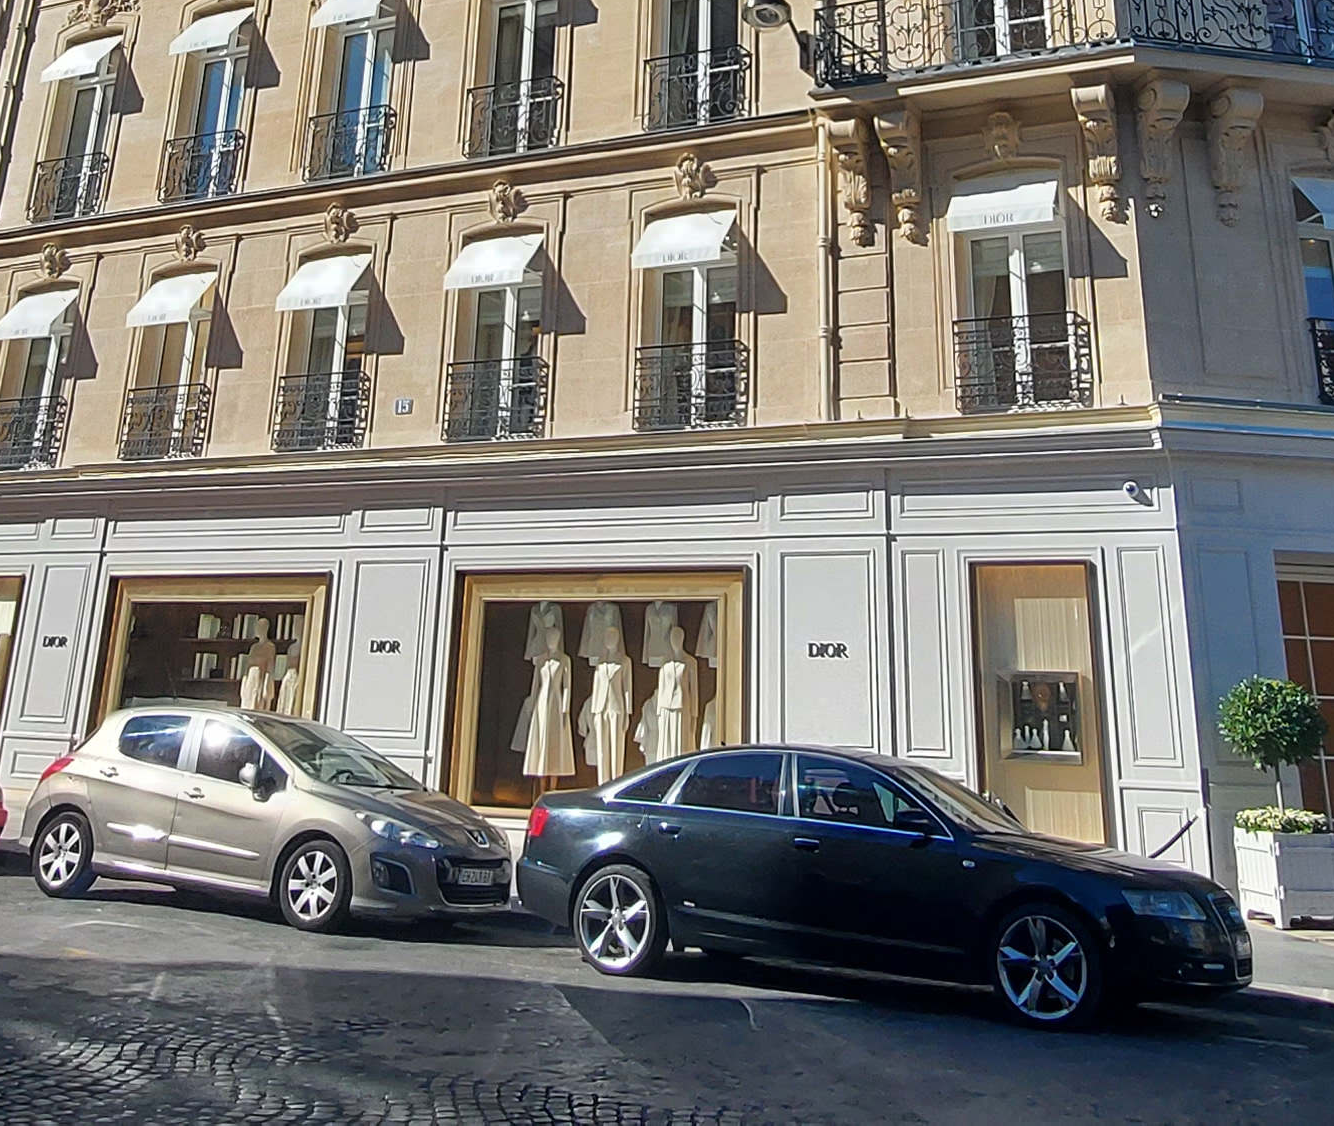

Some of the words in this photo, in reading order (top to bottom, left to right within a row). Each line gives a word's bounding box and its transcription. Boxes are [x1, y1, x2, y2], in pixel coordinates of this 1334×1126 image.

[983, 212, 1014, 225] DIOR
[662, 251, 688, 263] DIOR
[470, 274, 494, 284] DIOR
[397, 400, 410, 414] 15
[42, 636, 68, 648] DIOR
[369, 639, 402, 654] DIOR
[807, 642, 850, 659] DIOR
